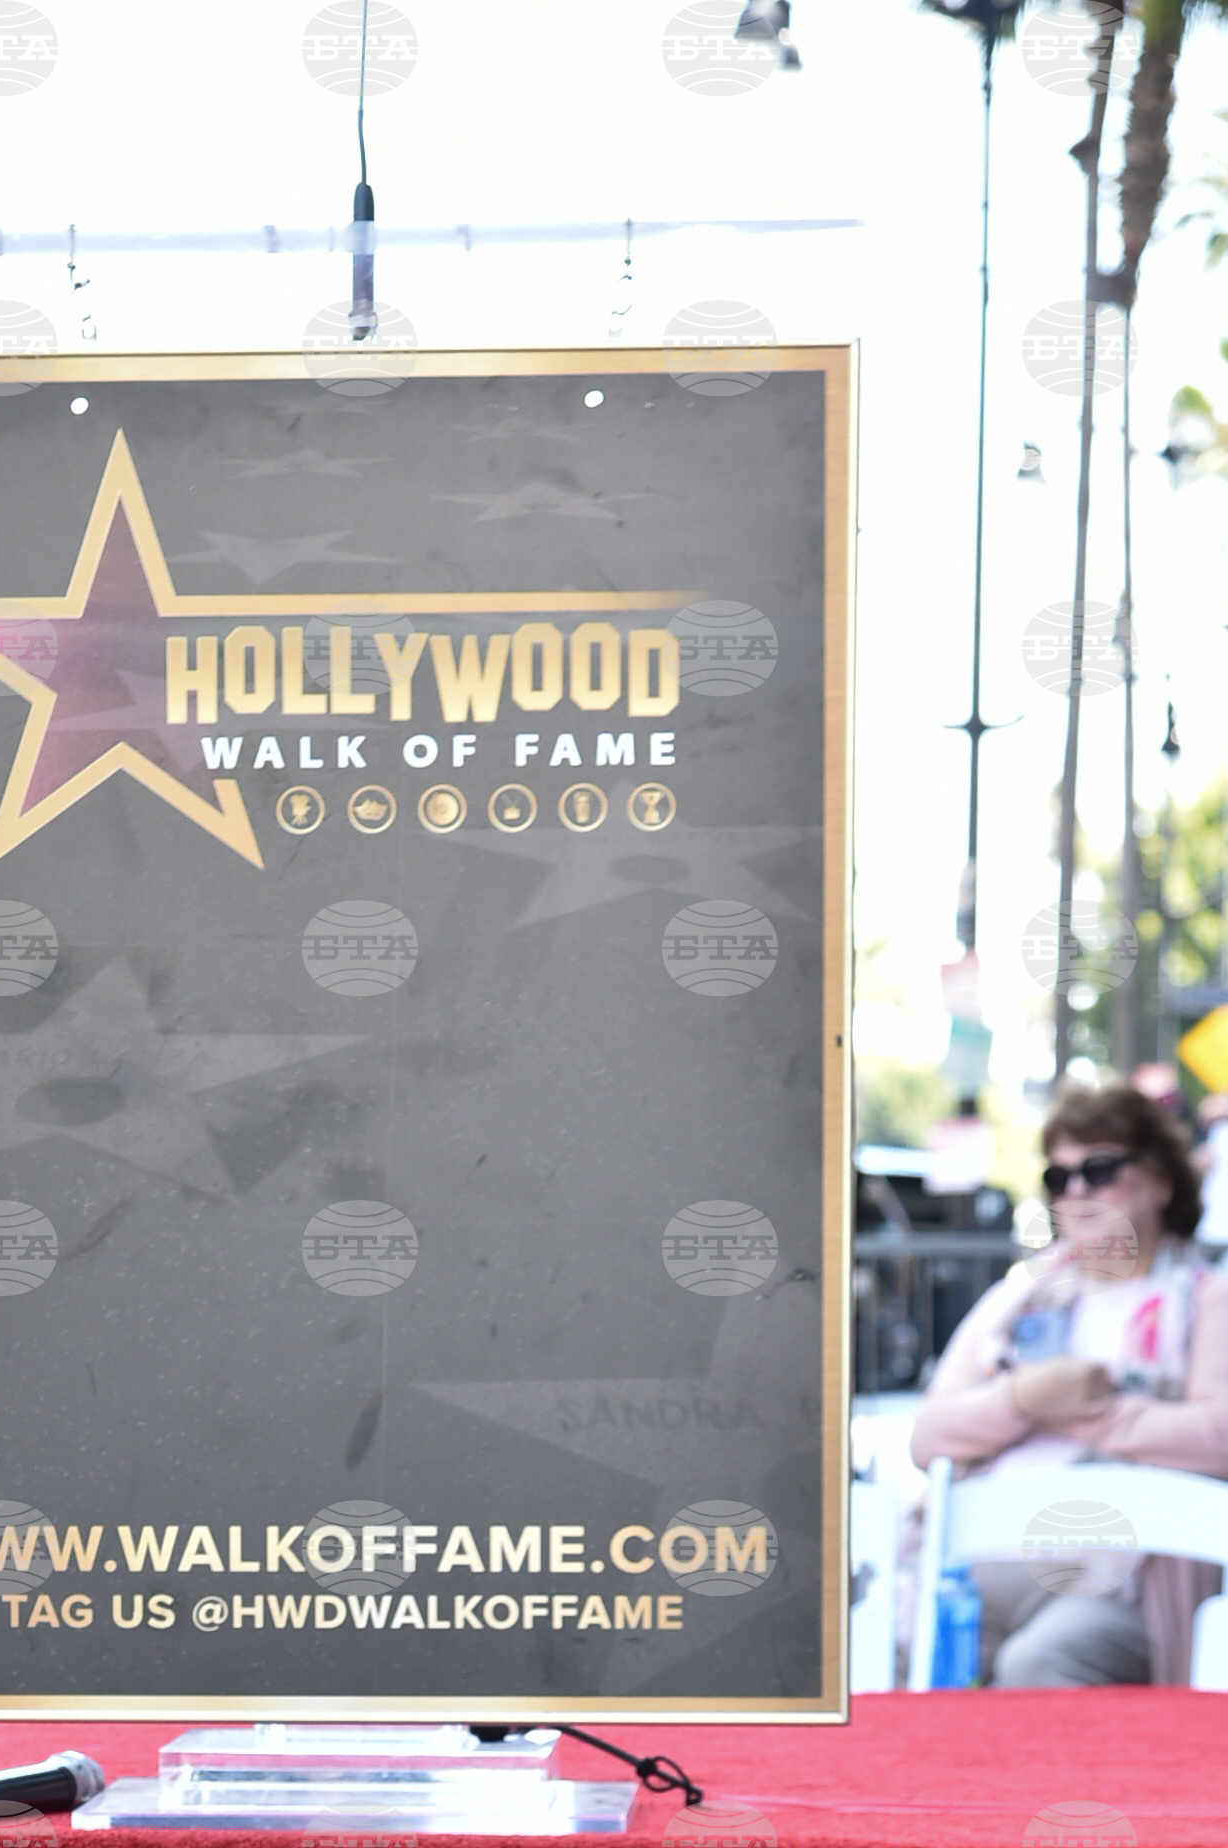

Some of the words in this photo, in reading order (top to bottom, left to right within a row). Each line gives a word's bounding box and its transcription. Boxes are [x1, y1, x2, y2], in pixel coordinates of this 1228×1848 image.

[166, 622, 680, 725] HOLLYWOOD
[201, 735, 368, 770] WALK
[402, 734, 477, 769] OF
[514, 732, 676, 767] FAME
[556, 1398, 767, 1432] SANDRA
[2, 1595, 93, 1629] TAG
[112, 1595, 176, 1629] US
[192, 1595, 683, 1632] @HWDWALKOFFAME
